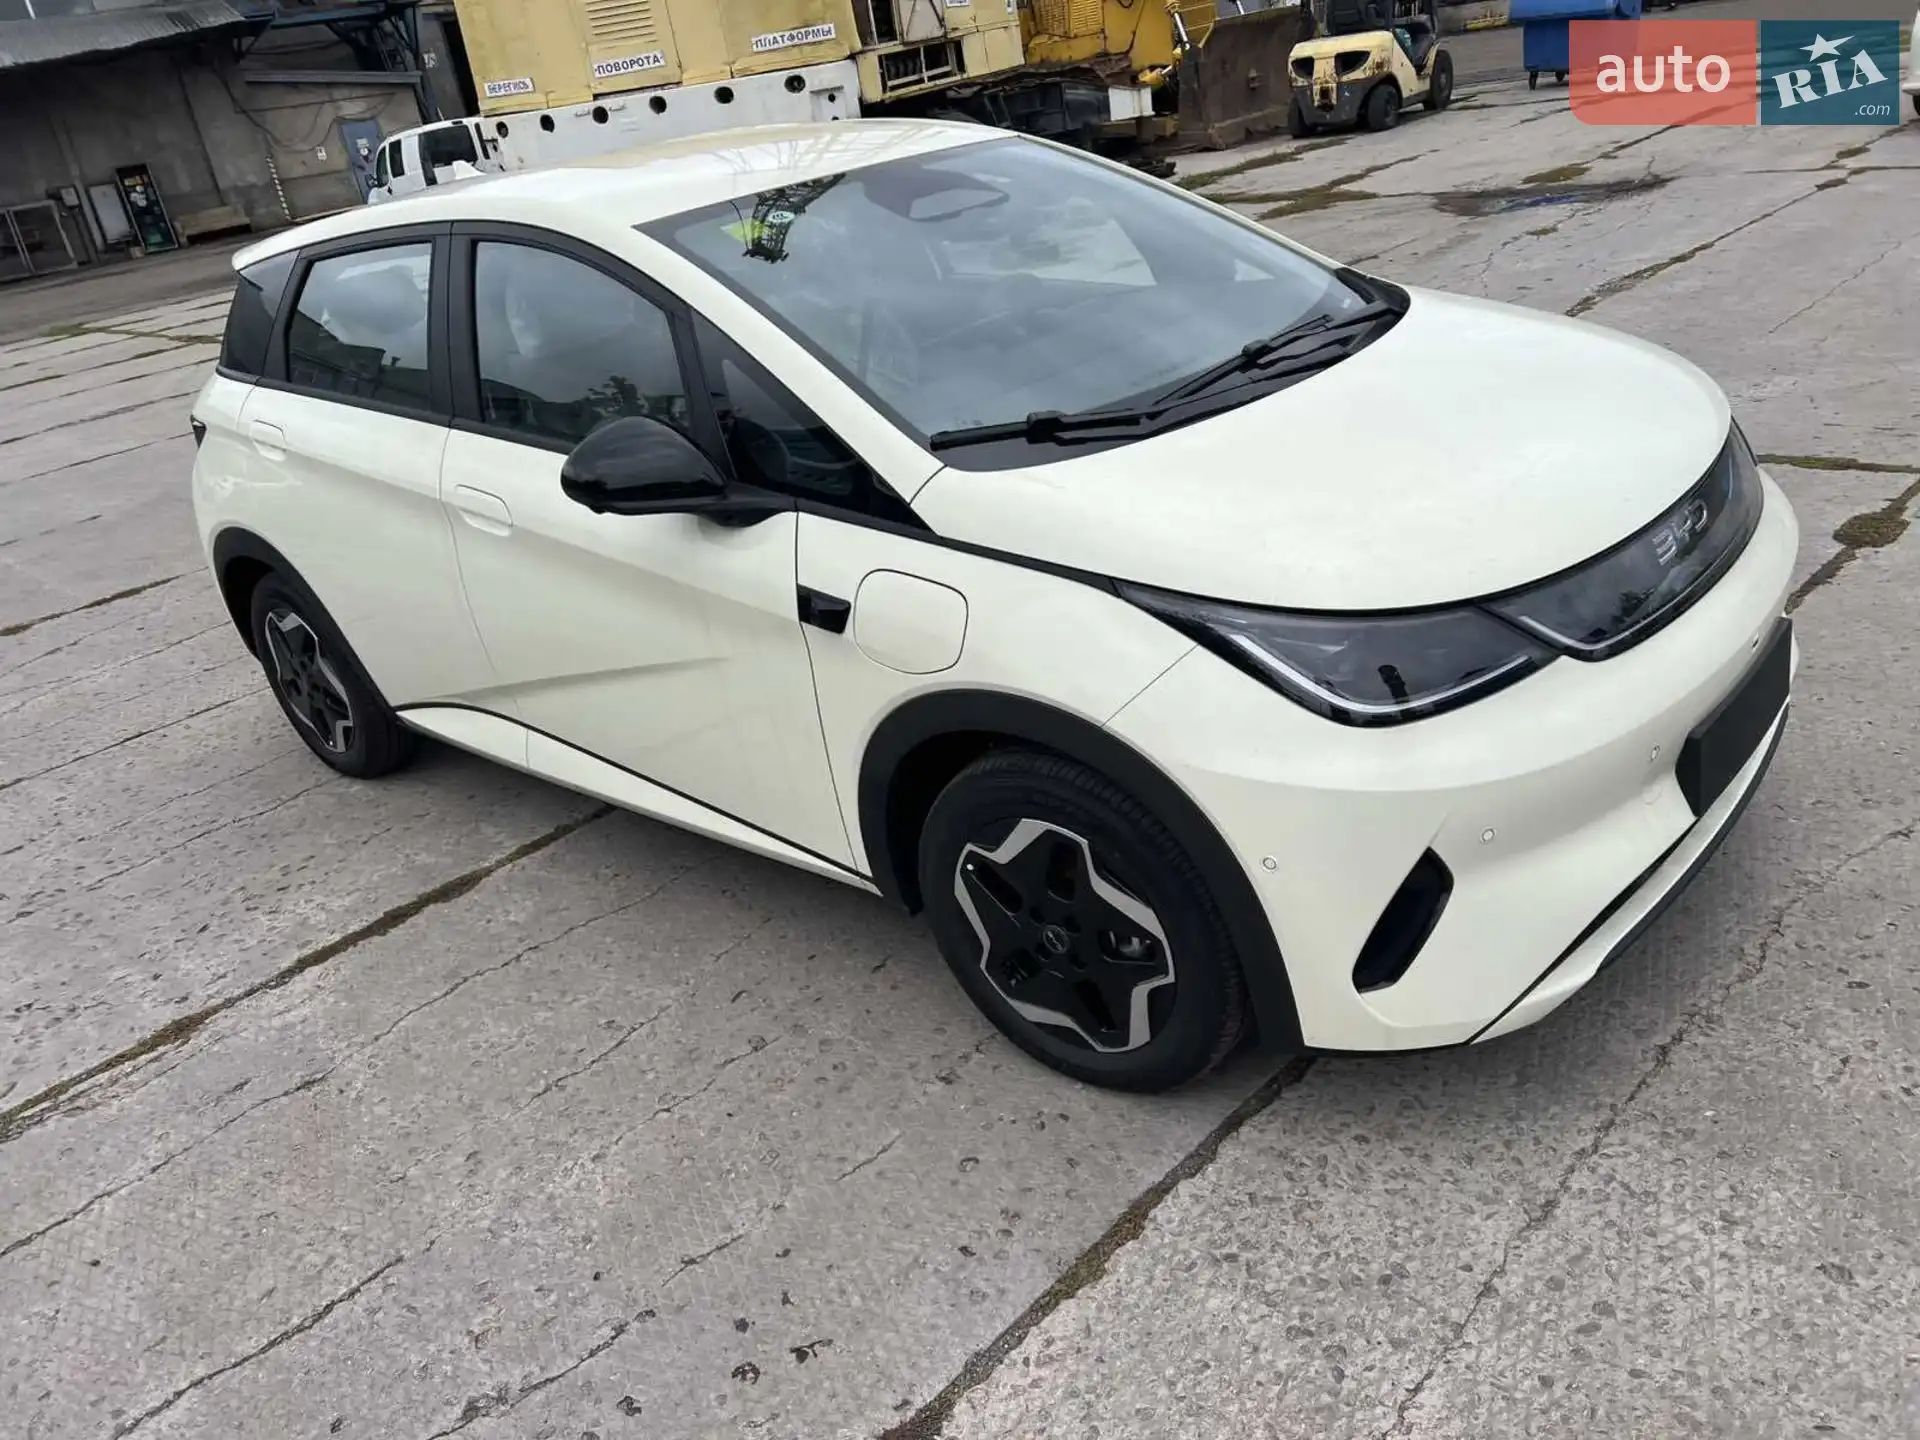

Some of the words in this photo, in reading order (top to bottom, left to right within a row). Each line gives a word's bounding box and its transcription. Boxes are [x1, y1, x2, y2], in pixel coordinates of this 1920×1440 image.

[596, 54, 661, 75] ПОВОРОТА
[755, 26, 833, 49] ПЛАТФОРМЫ
[1652, 498, 1708, 567] BYD
